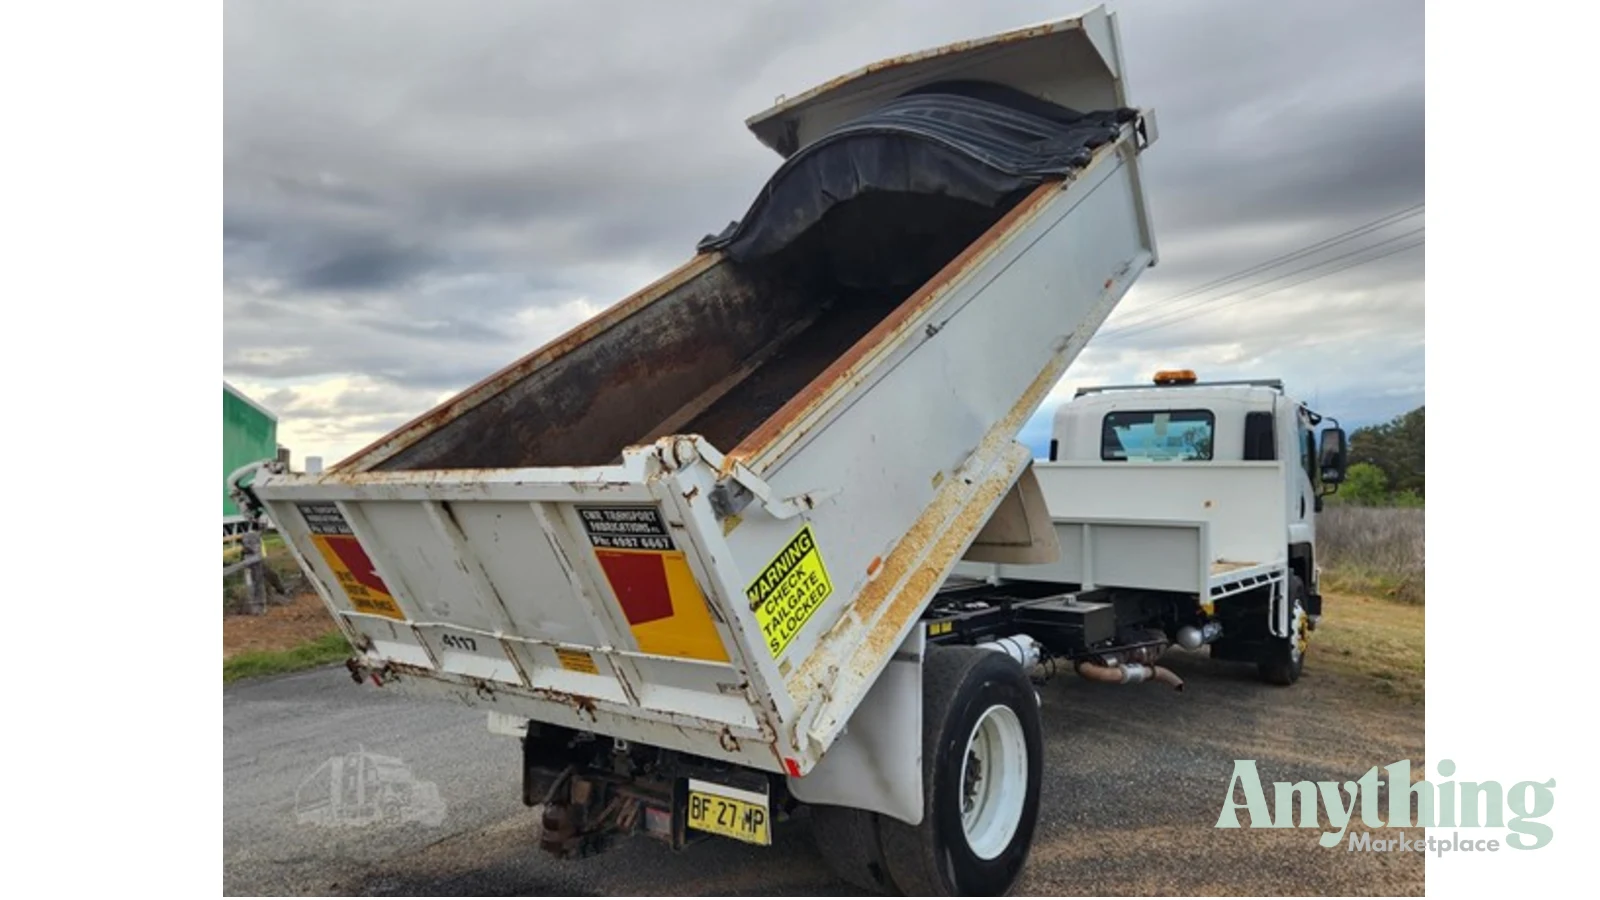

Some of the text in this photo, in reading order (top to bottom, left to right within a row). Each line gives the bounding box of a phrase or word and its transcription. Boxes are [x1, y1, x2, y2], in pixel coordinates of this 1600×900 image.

[603, 510, 657, 522] TRANSPORT
[763, 570, 820, 637] TAILGATE
[764, 564, 807, 615] CHECK
[780, 582, 827, 641] LOCKED
[443, 634, 477, 651] 4117
[691, 795, 711, 821] BF
[717, 801, 737, 828] 27
